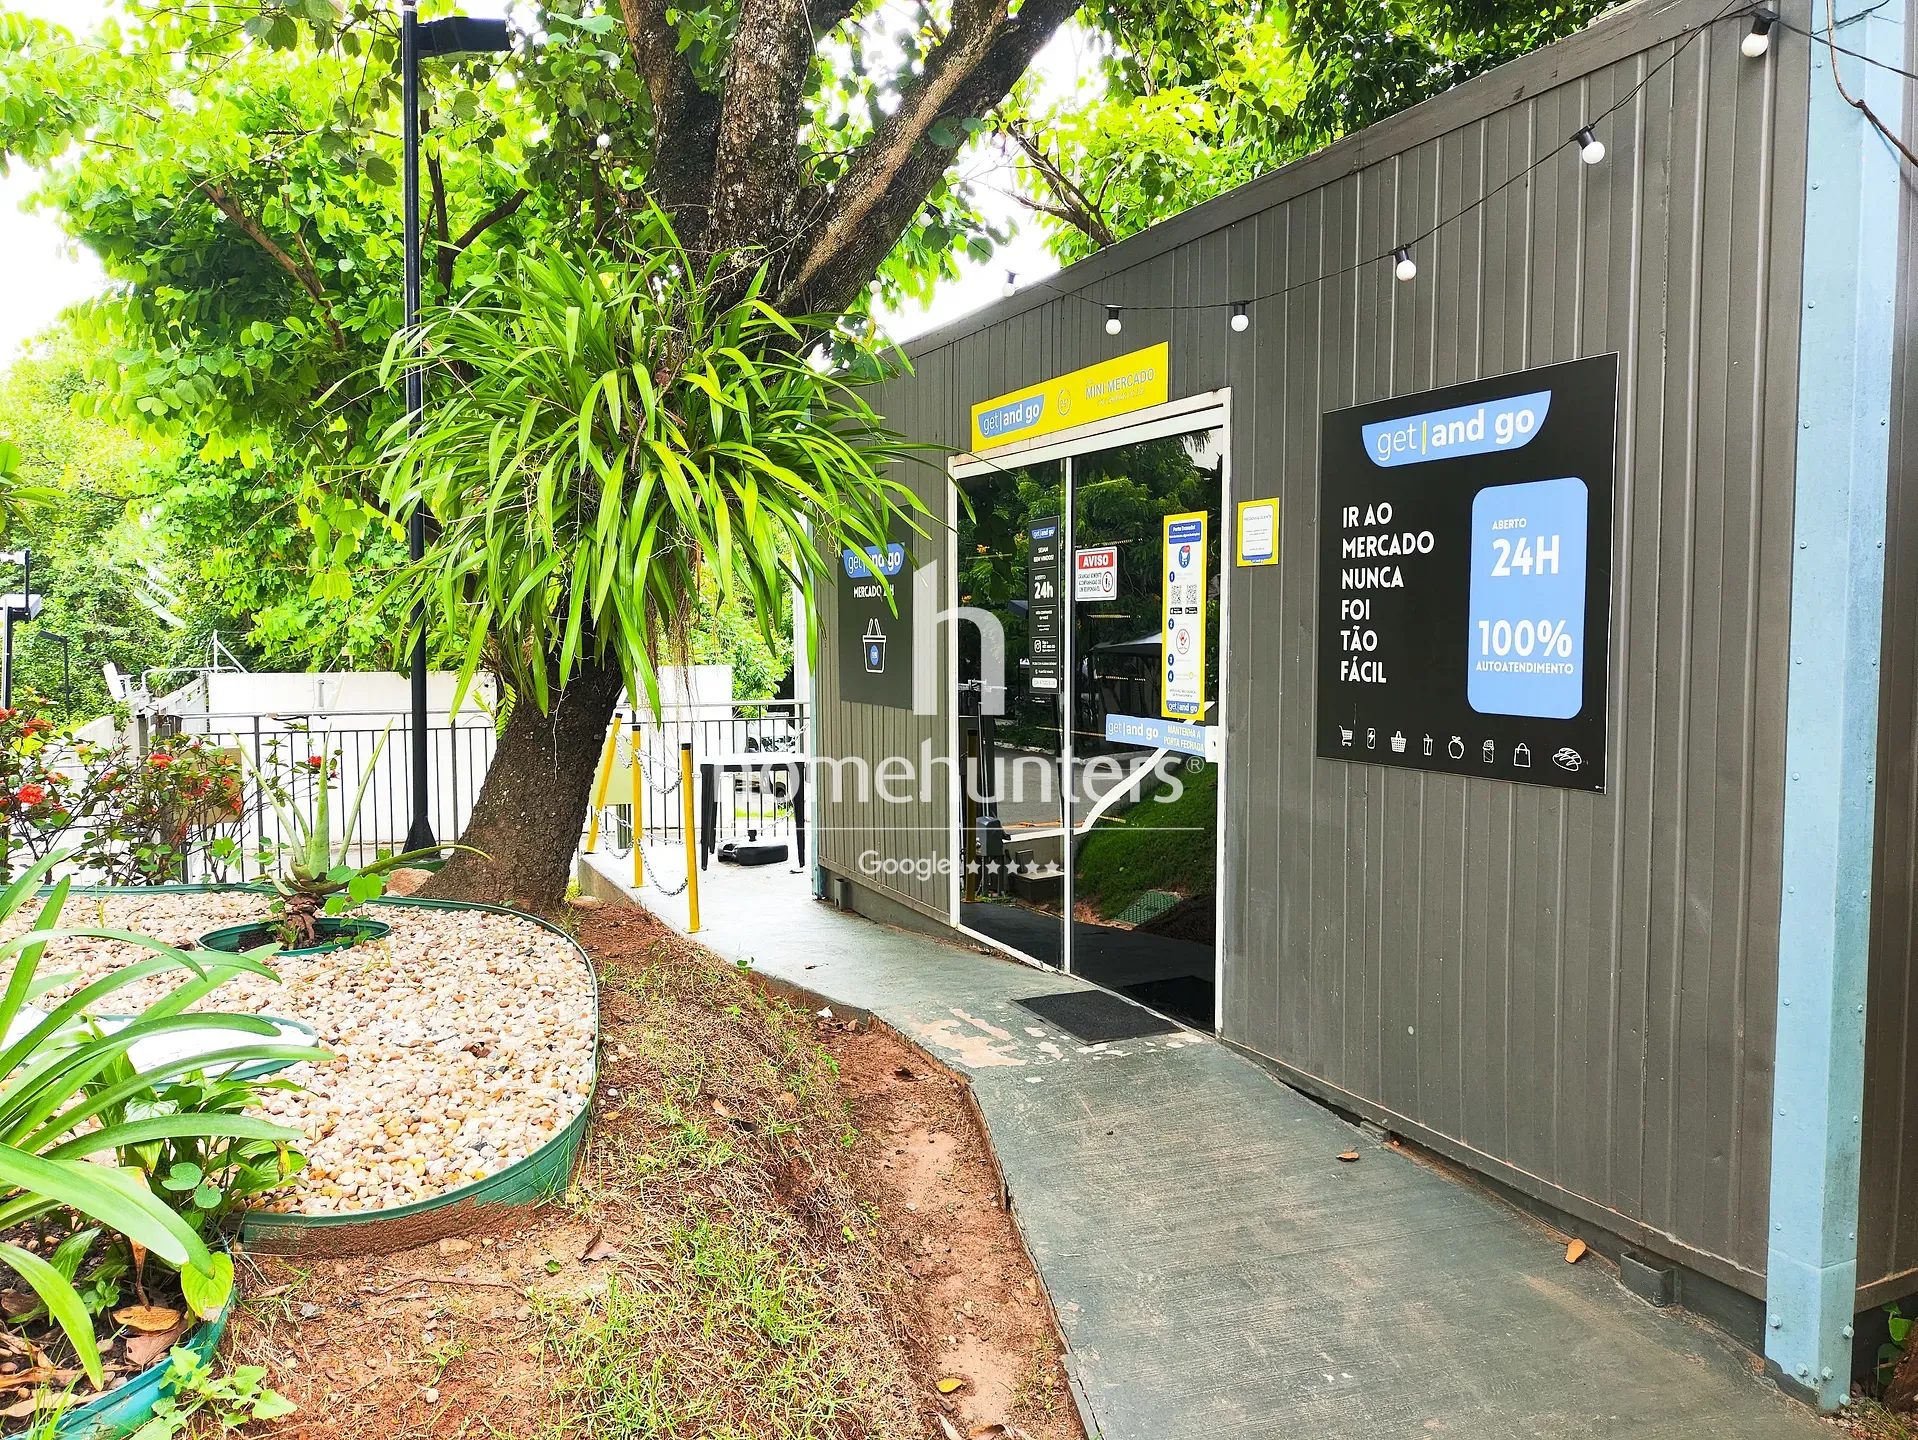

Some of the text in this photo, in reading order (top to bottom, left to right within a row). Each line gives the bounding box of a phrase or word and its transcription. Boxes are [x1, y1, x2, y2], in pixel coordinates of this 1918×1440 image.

[1086, 384, 1105, 400] MINI
[1107, 368, 1155, 393] MERCADO
[983, 413, 1000, 435] get
[1003, 406, 1022, 426] and
[1025, 403, 1040, 424] go
[1377, 408, 1535, 461] get and go
[1342, 502, 1393, 528] IR AO
[1491, 518, 1527, 530] ABERTO
[1342, 530, 1435, 559] MERCADO
[1490, 534, 1560, 577] 24H
[888, 551, 900, 571] go
[1083, 554, 1109, 568] AVISO
[1341, 565, 1404, 590] NUNCA
[853, 585, 882, 598] MERCADO
[1034, 581, 1053, 600] 24h
[1341, 598, 1370, 621] FOI
[1340, 625, 1378, 652] TÃO
[1478, 619, 1573, 658] 100%
[1340, 655, 1387, 683] FÁCIL
[1475, 660, 1574, 675] AUTOATENDIMENTO
[1168, 703, 1198, 714] get and go
[1108, 722, 1159, 740] get and go
[1167, 725, 1201, 739] MANTENHA A
[1163, 736, 1205, 752] PORTA FECHADA
